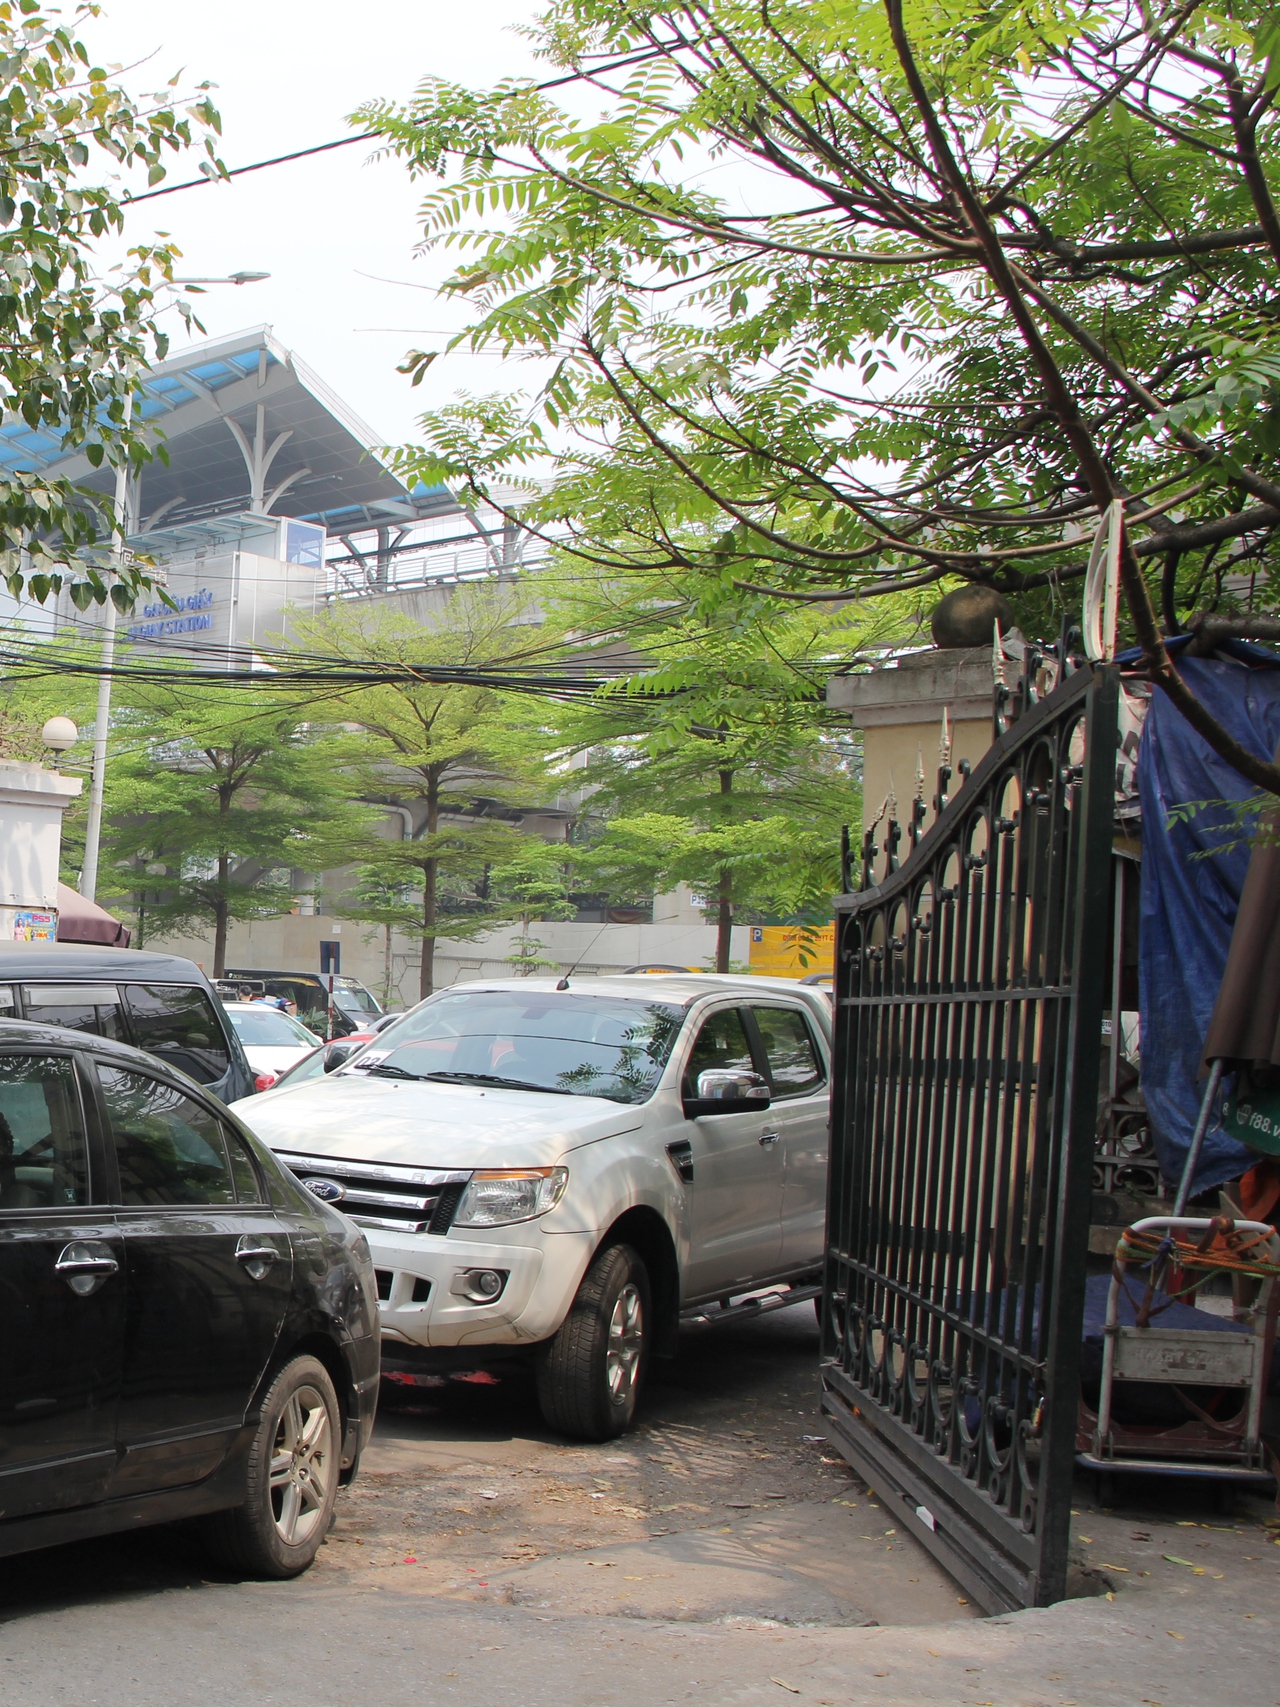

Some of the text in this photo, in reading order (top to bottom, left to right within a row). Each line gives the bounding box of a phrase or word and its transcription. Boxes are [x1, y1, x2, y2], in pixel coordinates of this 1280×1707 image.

[143, 603, 159, 618] GA
[164, 614, 213, 635] STATION
[753, 929, 762, 941] P
[1249, 1112, 1280, 1138] f88.v
[304, 1180, 332, 1198] Ford
